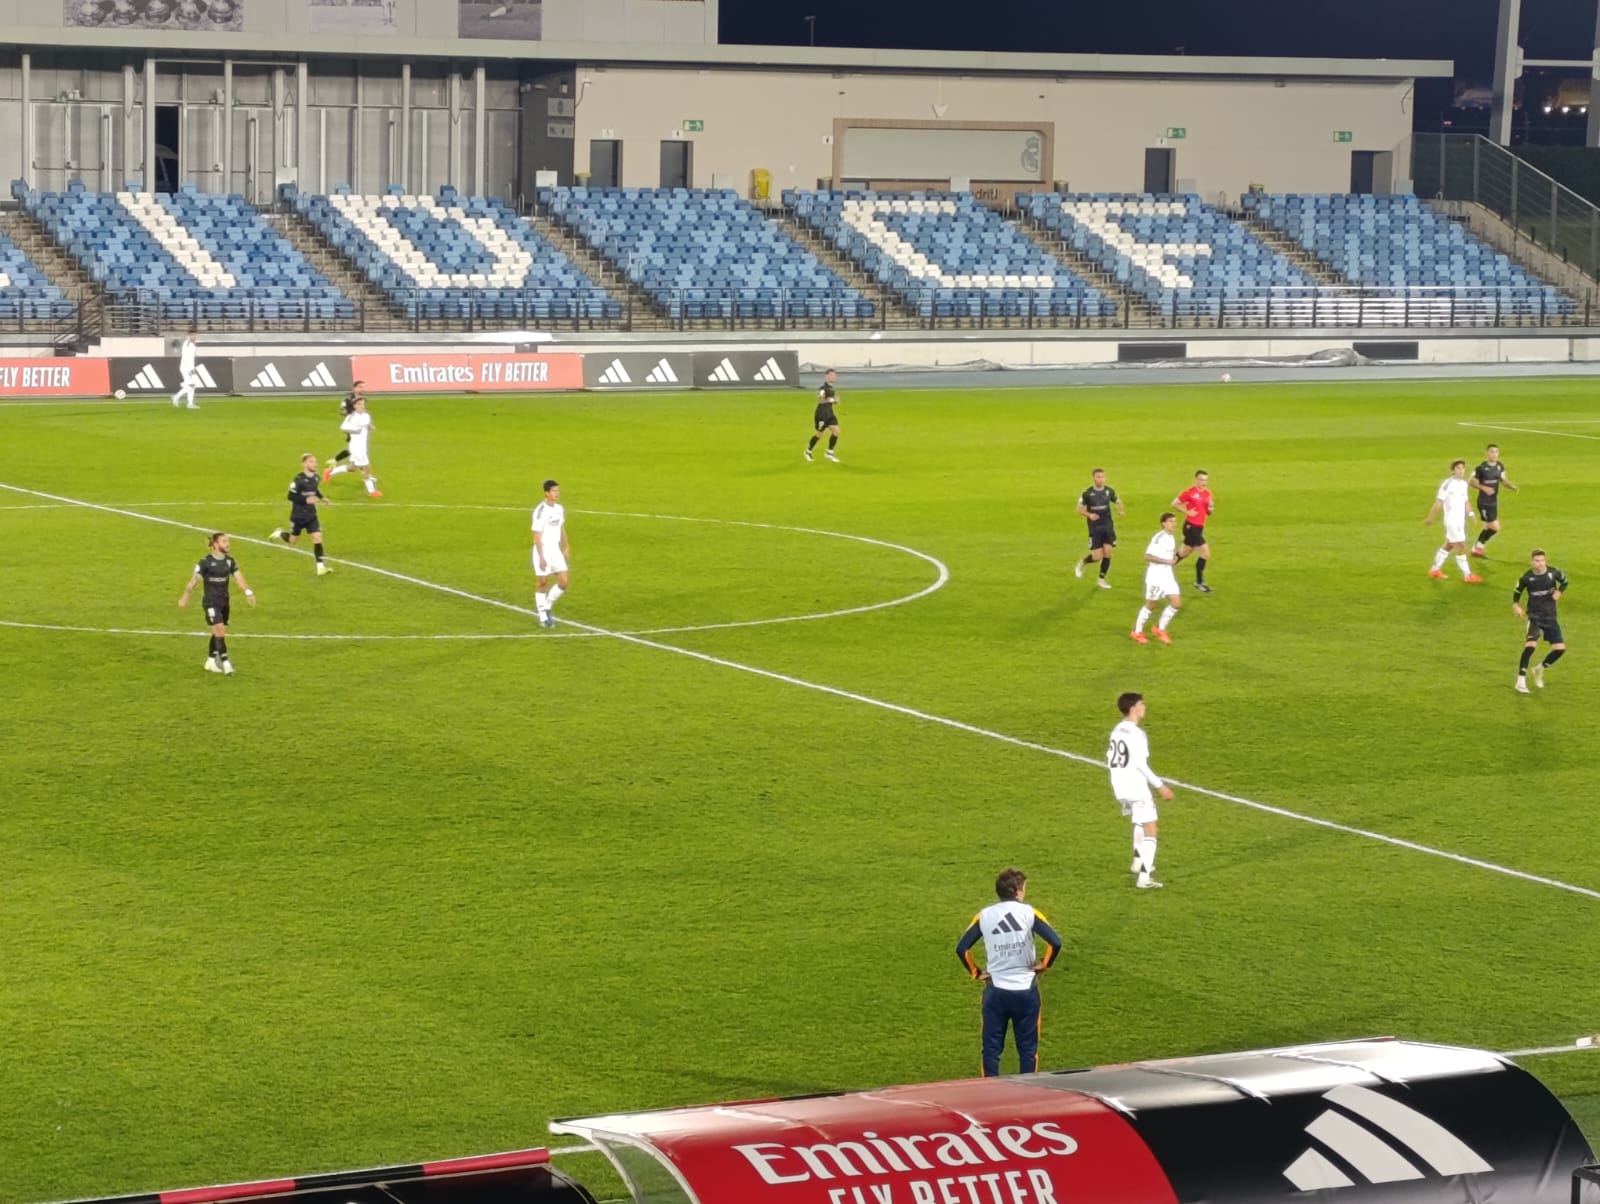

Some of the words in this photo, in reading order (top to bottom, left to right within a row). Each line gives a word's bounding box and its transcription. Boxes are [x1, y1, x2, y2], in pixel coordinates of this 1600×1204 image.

[0, 191, 533, 288] ID
[841, 200, 1212, 288] CF
[22, 366, 71, 388] BETTER
[389, 363, 474, 384] Emirates
[480, 363, 502, 383] FLY
[504, 362, 548, 382] BETTER
[1110, 739, 1129, 768] 29
[732, 1121, 1079, 1185] Emirates
